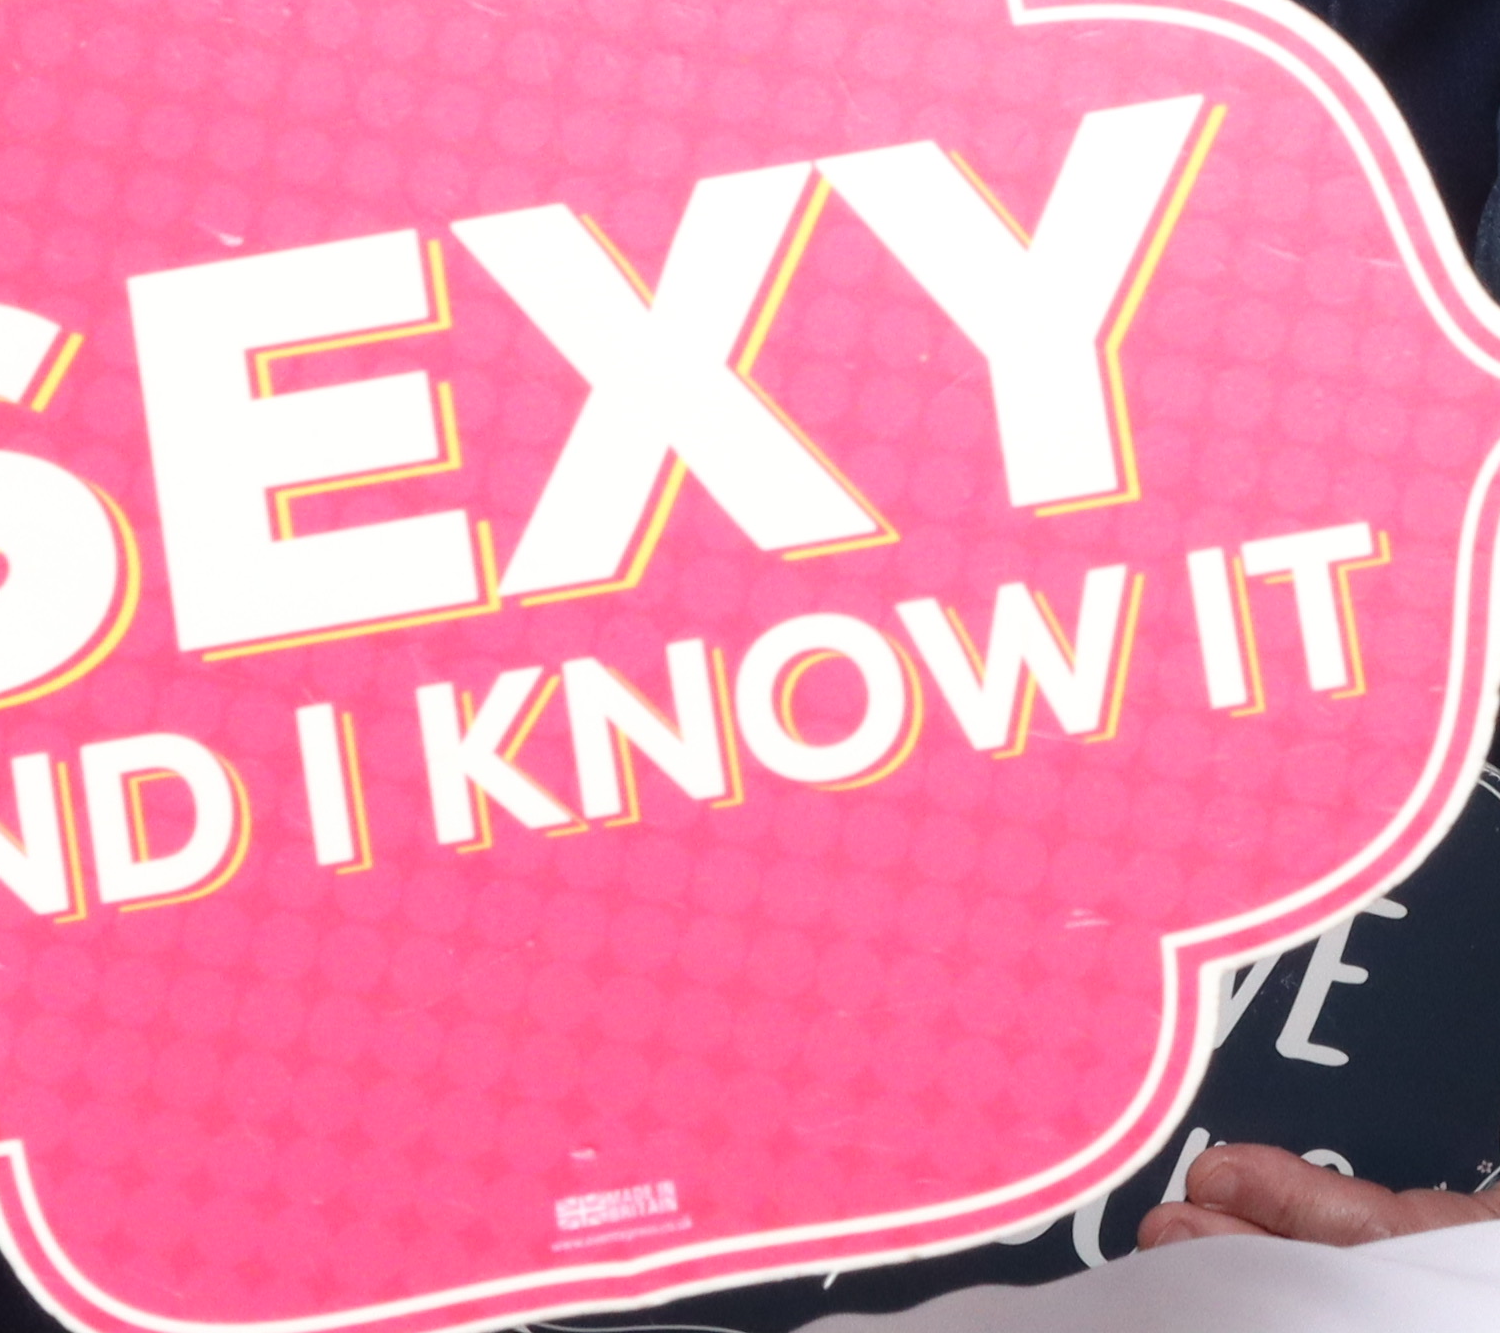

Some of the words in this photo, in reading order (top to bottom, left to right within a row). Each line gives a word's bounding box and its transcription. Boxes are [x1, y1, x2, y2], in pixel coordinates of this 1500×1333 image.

[295, 701, 373, 876] I
[416, 562, 1146, 854] KNOW
[1186, 520, 1391, 717] IT
